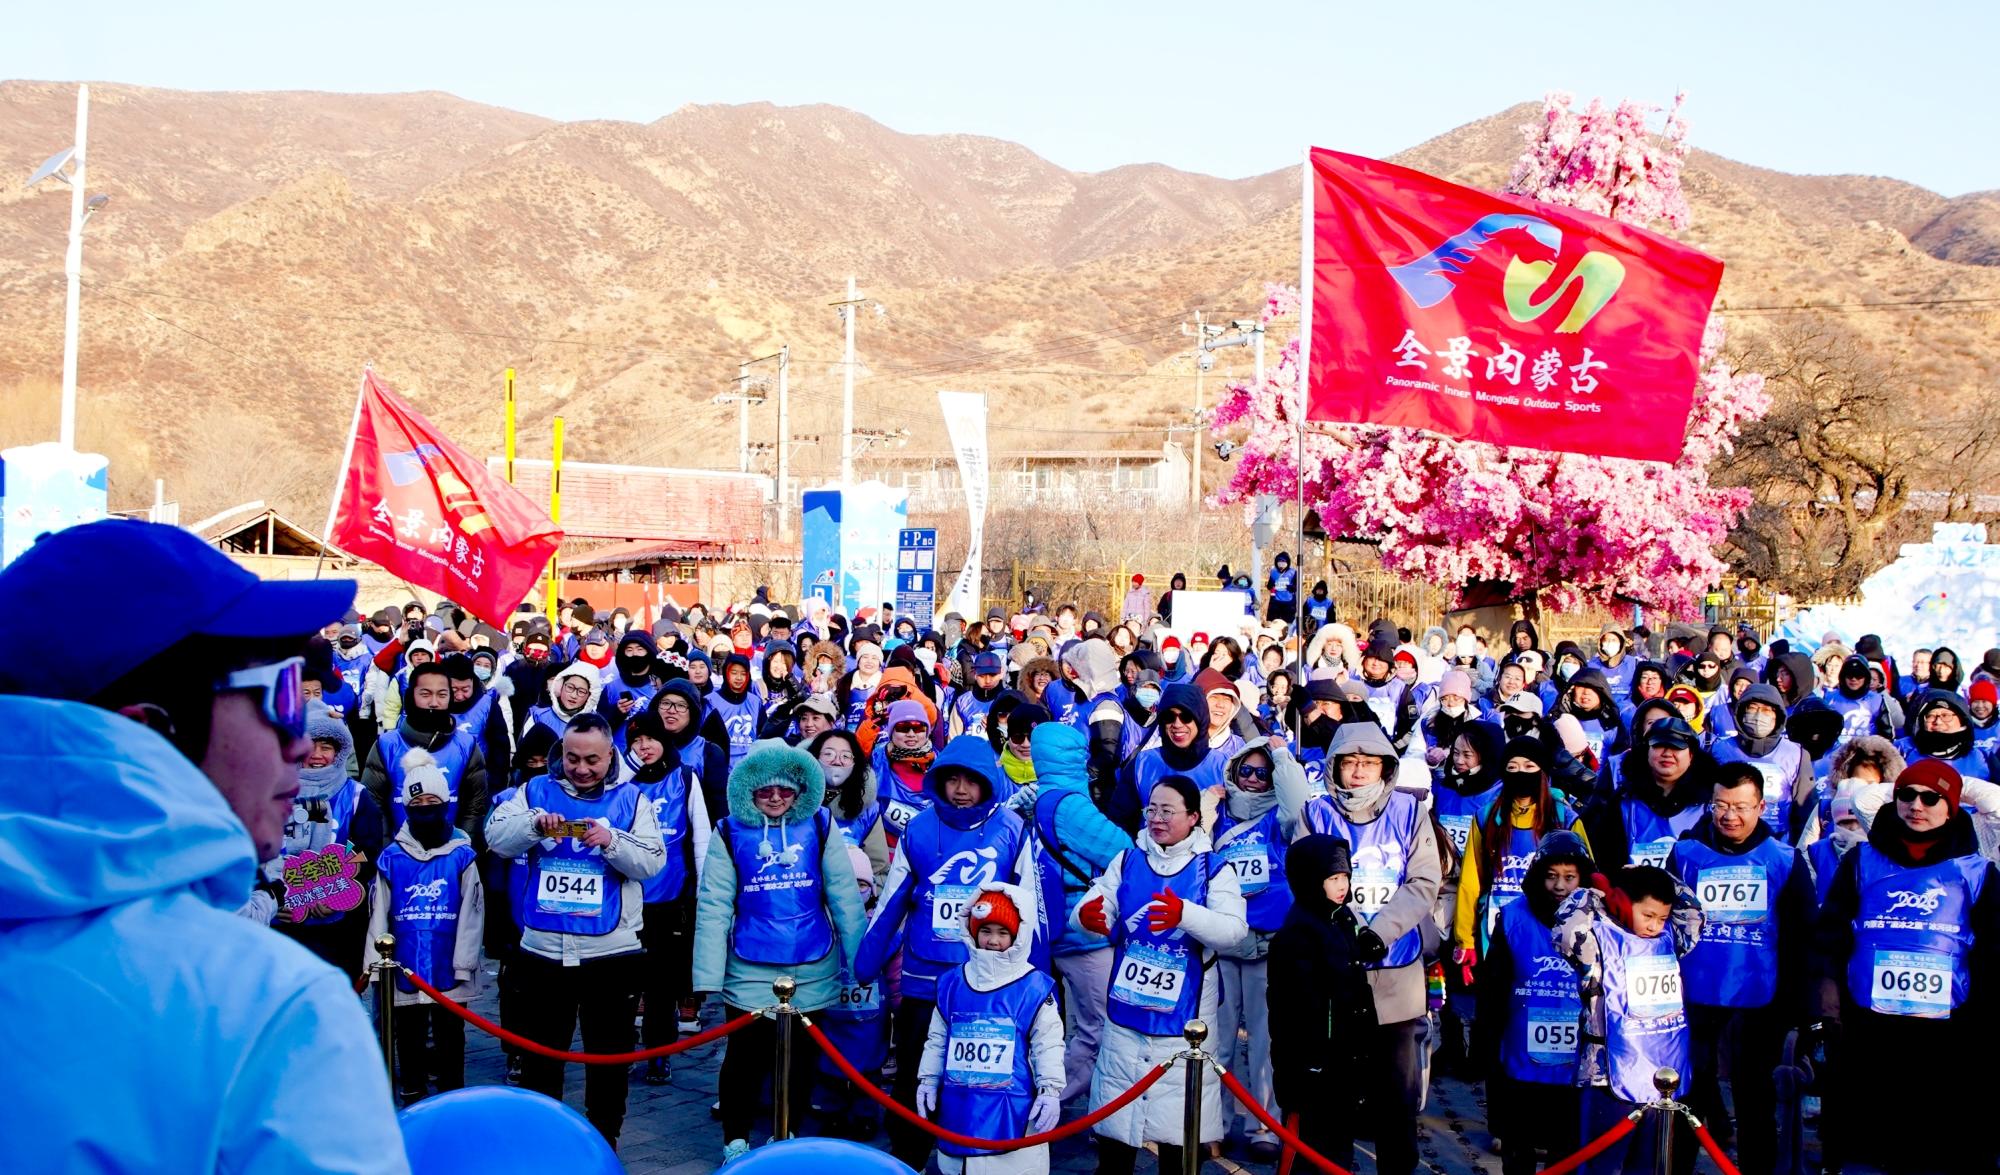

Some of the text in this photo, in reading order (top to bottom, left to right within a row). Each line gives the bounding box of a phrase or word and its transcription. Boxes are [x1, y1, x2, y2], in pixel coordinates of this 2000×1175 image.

[1392, 328, 1608, 394] 全景内蒙古
[1385, 375, 1602, 413] Panoramic Inner Mongolia Outdoor Sports
[372, 497, 485, 578] 全景内蒙古
[913, 531, 921, 546] P
[891, 808, 911, 826] 03
[1449, 828, 1466, 844] 35
[284, 853, 342, 888] 冬季游
[1230, 859, 1263, 877] 78
[545, 875, 597, 896] 0544
[1351, 886, 1390, 905] 612
[1703, 883, 1761, 903] 0767
[939, 902, 963, 921] 05
[1702, 922, 1764, 941] 景内蒙古
[1125, 962, 1176, 990] 0543
[1635, 973, 1677, 996] 0766
[1881, 970, 1943, 994] 0689
[840, 986, 873, 1004] 667
[1534, 1025, 1576, 1045] 055
[953, 1041, 1007, 1064] 0807
